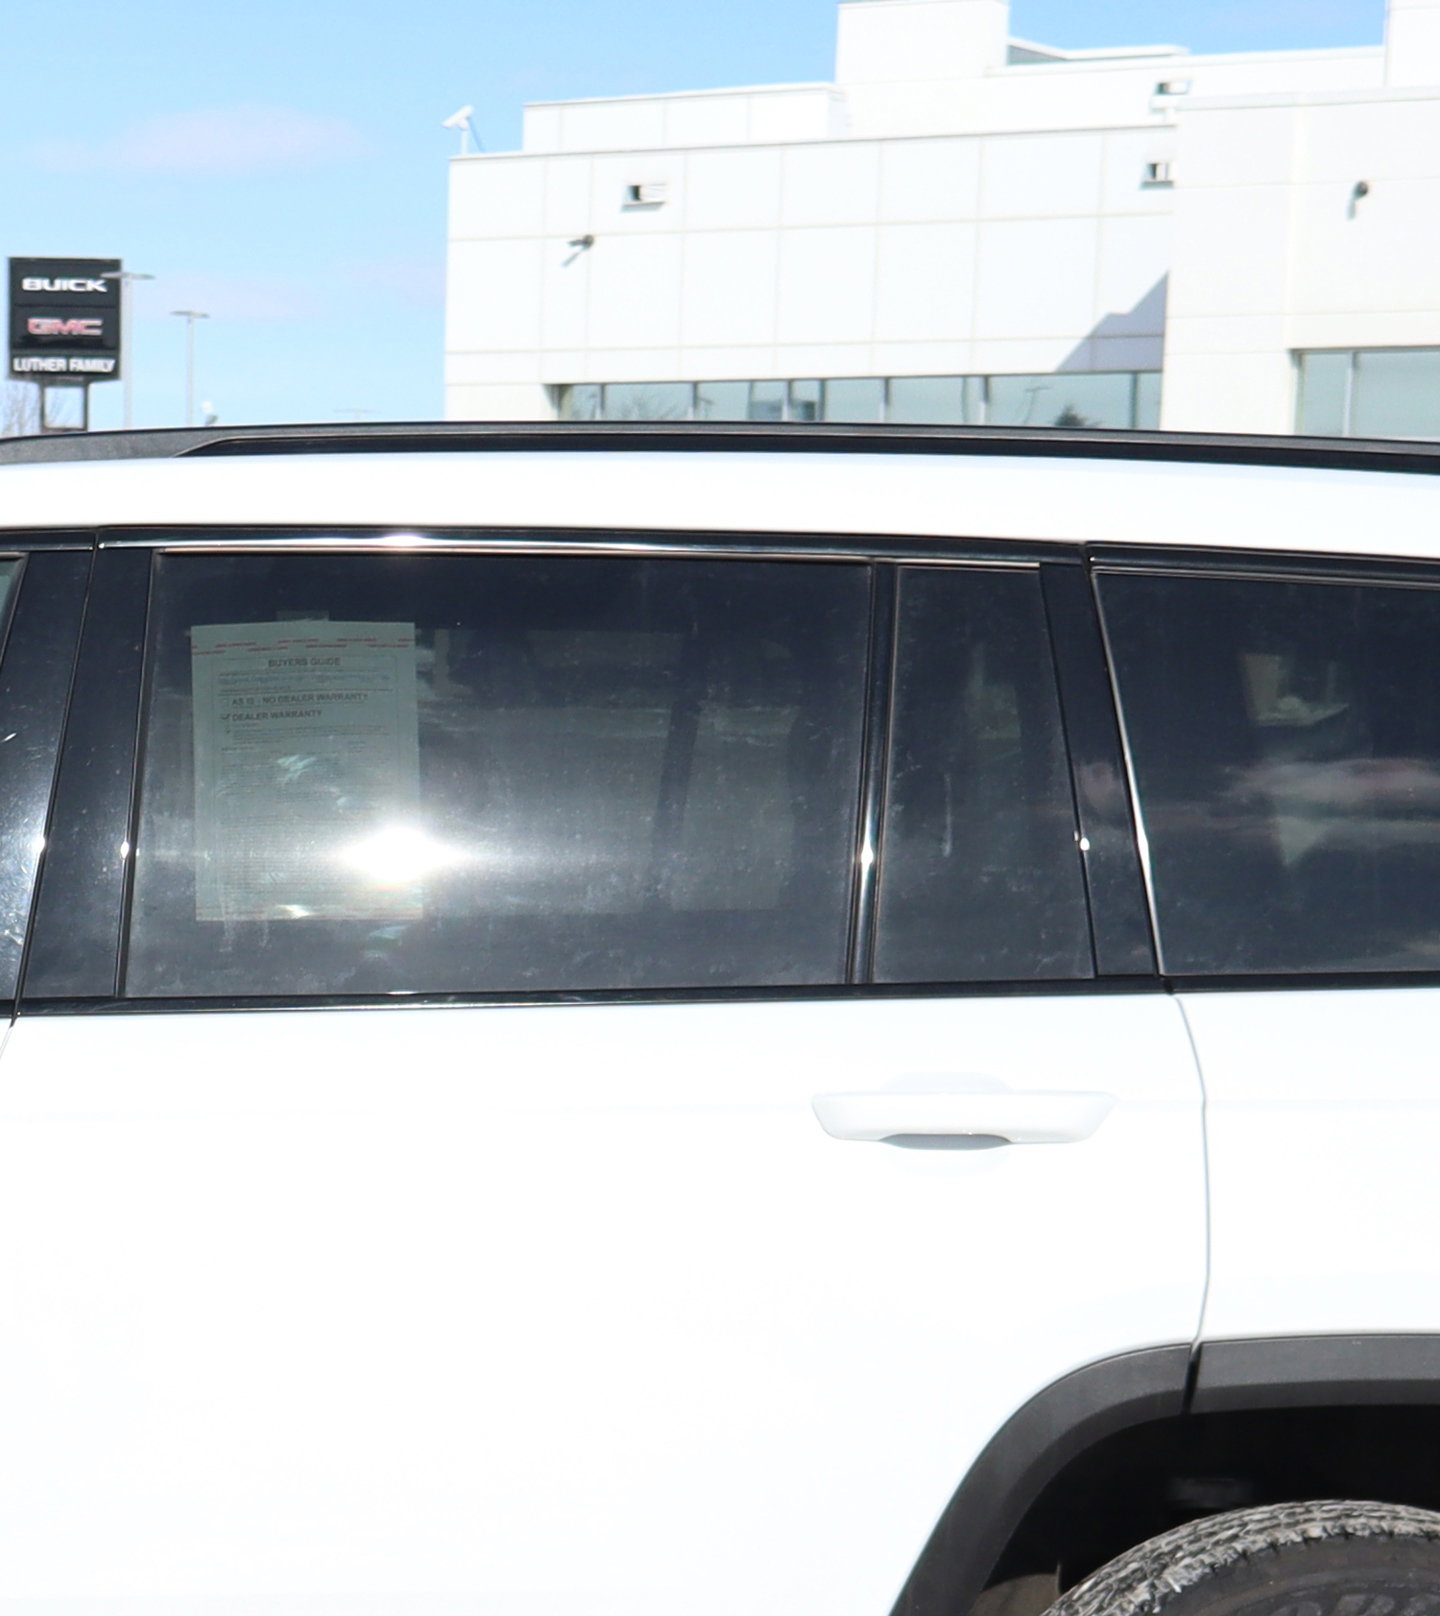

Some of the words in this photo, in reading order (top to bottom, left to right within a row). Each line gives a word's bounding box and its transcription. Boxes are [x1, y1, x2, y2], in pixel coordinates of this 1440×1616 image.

[22, 277, 108, 293] BUICK
[27, 318, 103, 336] GMC
[13, 357, 67, 372] LUTHER
[68, 357, 116, 373] FAMILY
[268, 657, 308, 667] BUYERS
[310, 656, 341, 667] GUIDE
[262, 695, 276, 705] NO
[277, 693, 314, 704] DEALER
[316, 691, 368, 702] WARRANTY
[232, 711, 268, 722] DEALER
[270, 709, 322, 720] WARRANTY
